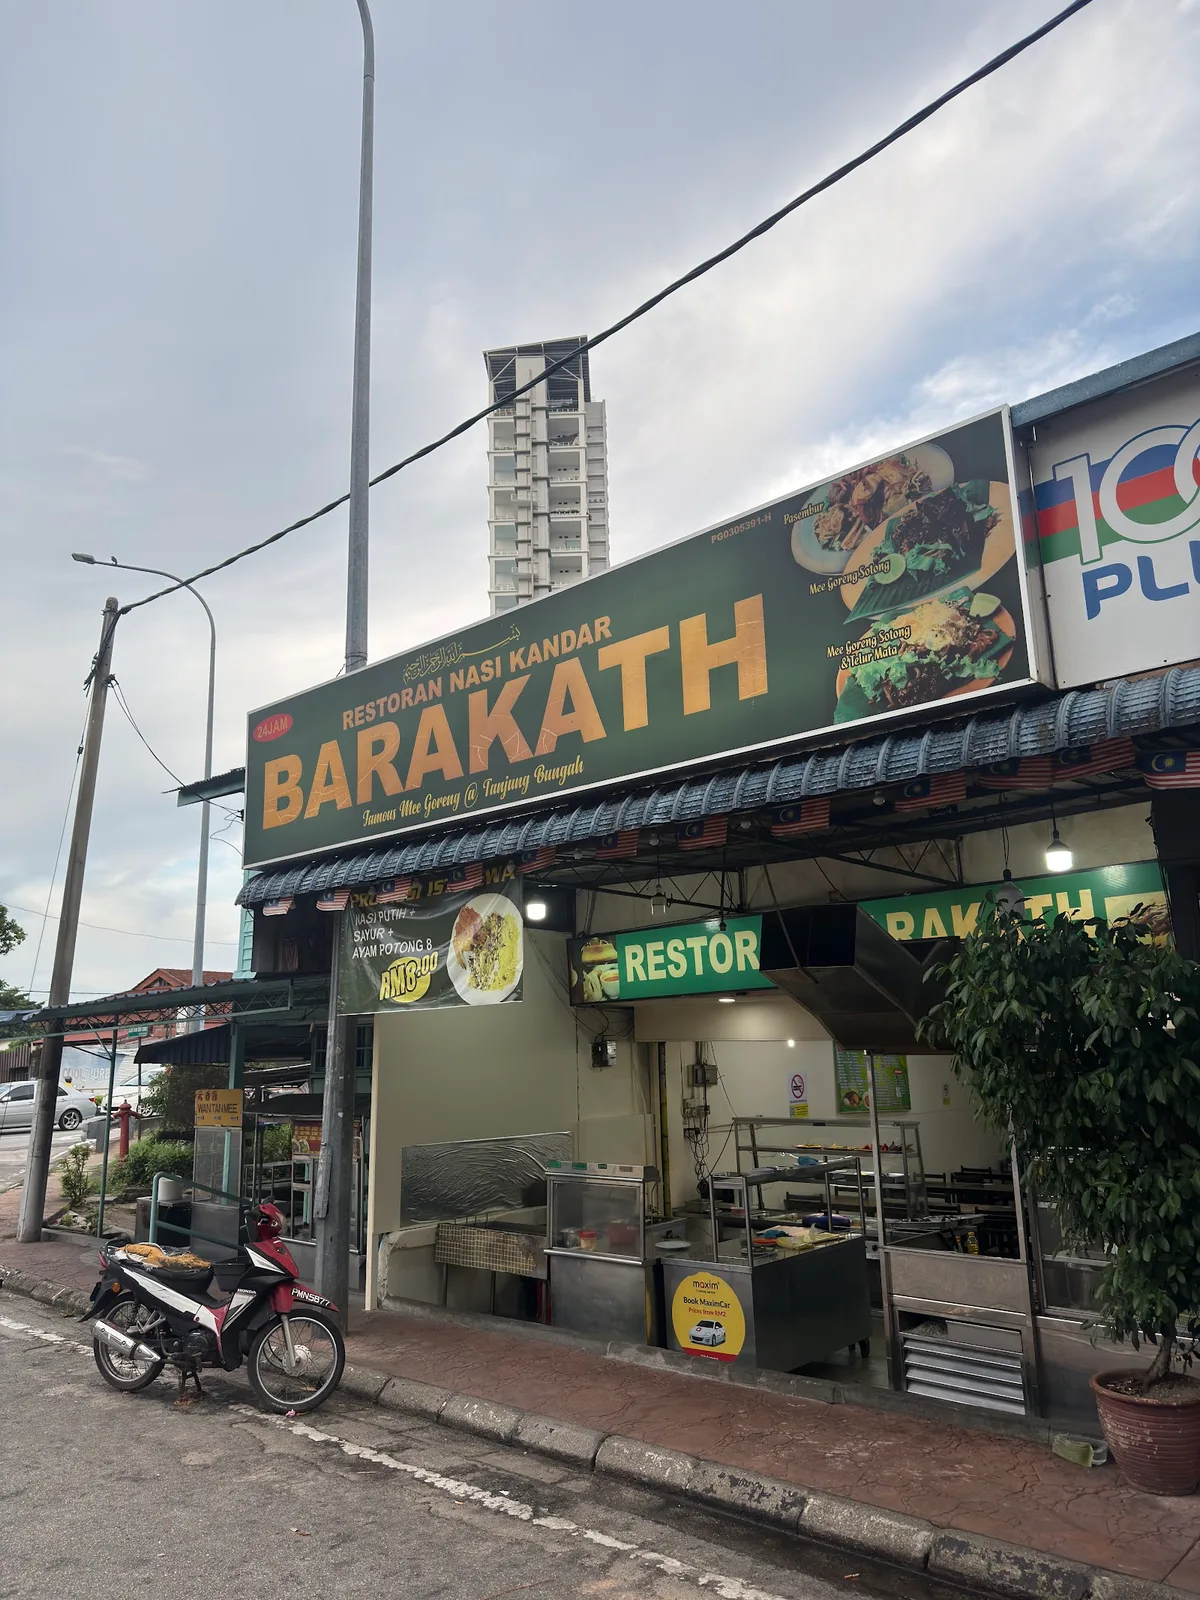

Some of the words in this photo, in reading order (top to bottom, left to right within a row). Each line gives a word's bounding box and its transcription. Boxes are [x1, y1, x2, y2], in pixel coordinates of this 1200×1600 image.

[1052, 416, 1200, 566] 10
[783, 501, 825, 525] Pasembur
[711, 512, 772, 544] PG0305391-H
[809, 580, 826, 595] Mee
[827, 569, 858, 591] Goreng
[858, 560, 891, 580] Sotong
[826, 644, 844, 659] Mee
[845, 633, 877, 654] Goreng
[878, 625, 911, 643] Sotong
[874, 645, 898, 660] Mata
[343, 677, 442, 731] RESTORAN
[450, 656, 501, 693] NASI
[510, 615, 613, 672] KANDAR
[262, 593, 768, 830] BARAKATH
[257, 715, 289, 740] 24JAM
[362, 809, 396, 827] Famous
[399, 799, 421, 817] Mee
[424, 792, 460, 819] Goreng
[464, 781, 479, 808] @
[483, 773, 530, 800] Tanjung
[534, 755, 584, 784] Bungah
[355, 911, 377, 926] NASI
[379, 908, 407, 924] PUTIH
[353, 928, 385, 943] SAYUR
[352, 945, 377, 960] AYAM
[379, 939, 424, 956] POTONG
[426, 938, 433, 951] 8
[379, 951, 439, 1001] RM8.00
[291, 1287, 331, 1307] PMN5877
[693, 1280, 718, 1290] maxim
[683, 1296, 699, 1305] Book
[700, 1298, 730, 1309] MaximCar
[688, 1307, 702, 1315] Prices
